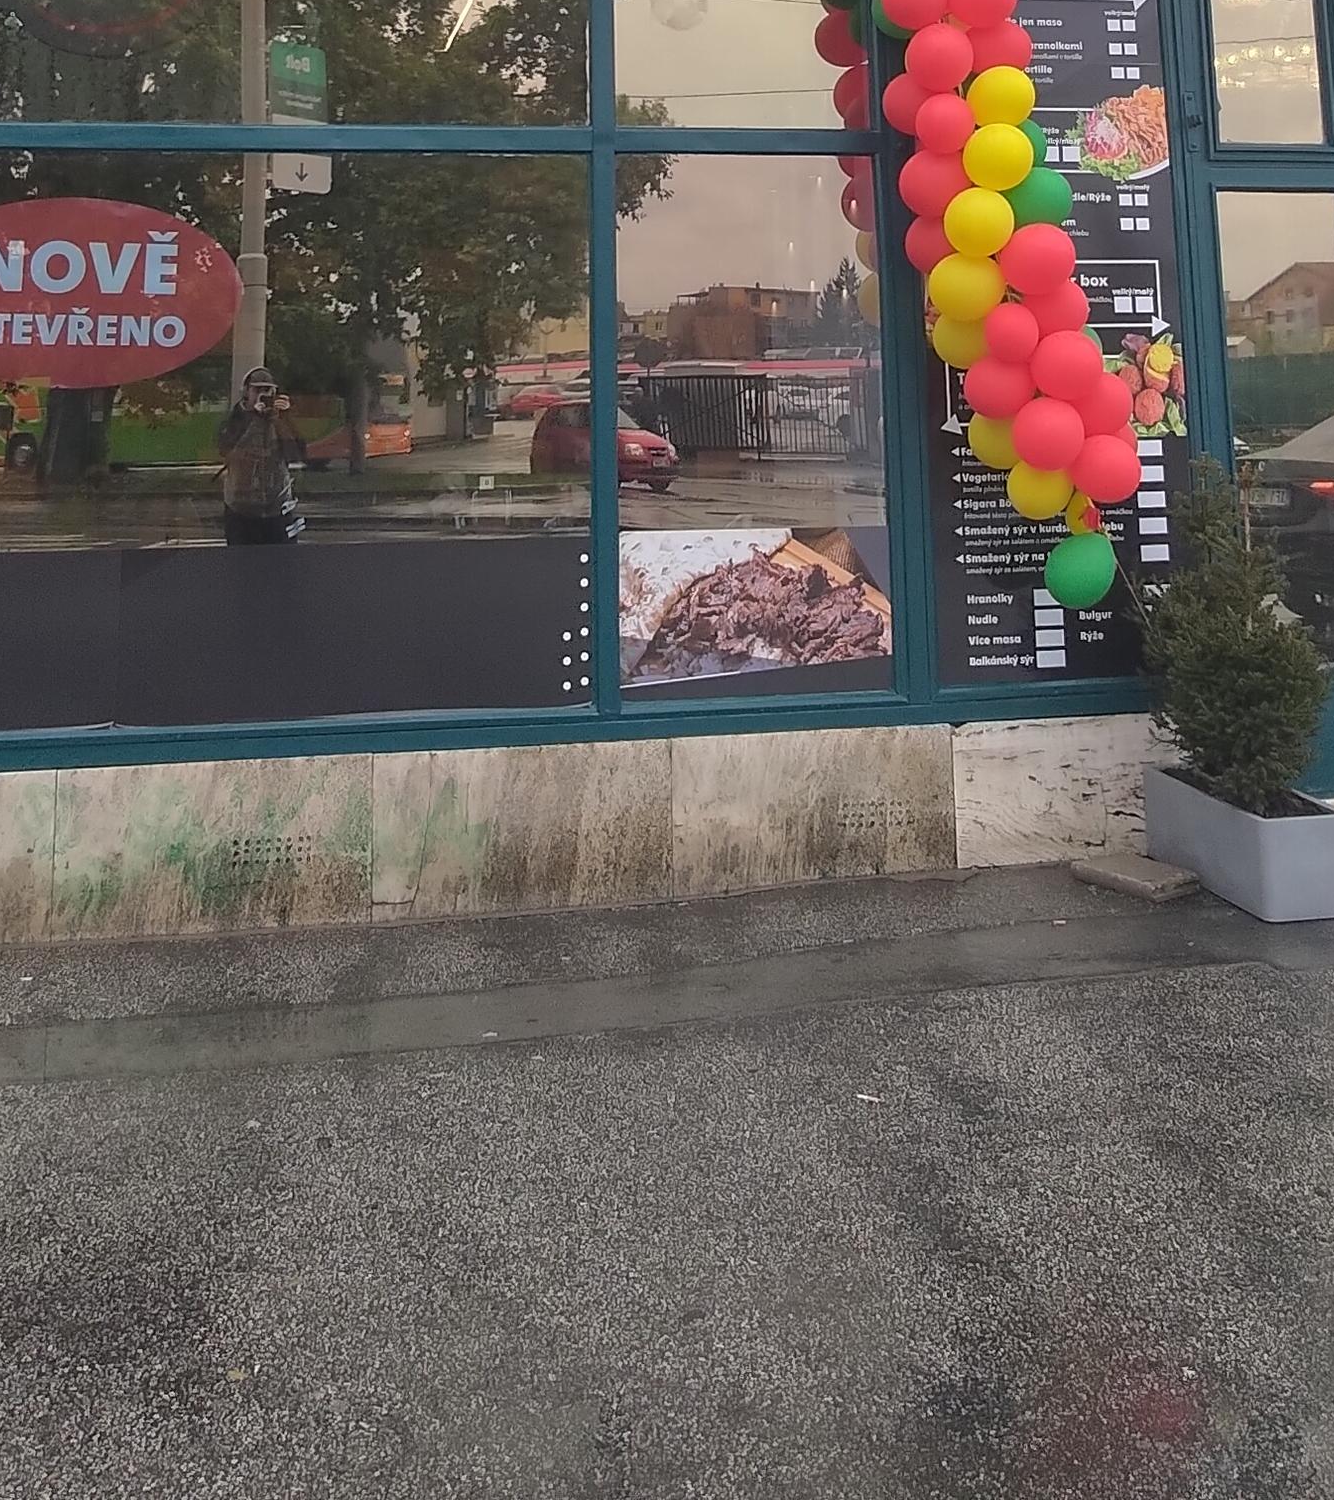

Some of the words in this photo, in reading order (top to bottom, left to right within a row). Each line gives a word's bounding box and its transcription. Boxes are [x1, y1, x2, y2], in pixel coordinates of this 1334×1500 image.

[1019, 17, 1034, 27] jen
[1036, 18, 1063, 27] maso
[1024, 65, 1053, 74] ortille
[1080, 273, 1109, 287] box
[963, 498, 997, 511] Sigara
[964, 525, 1011, 536] Smažený
[1012, 523, 1029, 535] sýr
[1029, 525, 1038, 533] v
[965, 553, 1012, 564] Smažený
[1013, 551, 1030, 563] sýr
[1031, 553, 1045, 561] na
[967, 593, 1014, 605] Hranolky
[967, 614, 999, 625] Nudle
[1078, 610, 1113, 621] Bulgur
[968, 634, 991, 646] Více
[992, 635, 1022, 644] masa
[1080, 630, 1104, 642] Rýže
[969, 654, 1019, 667] Balkánský
[1019, 653, 1035, 665] sýr
